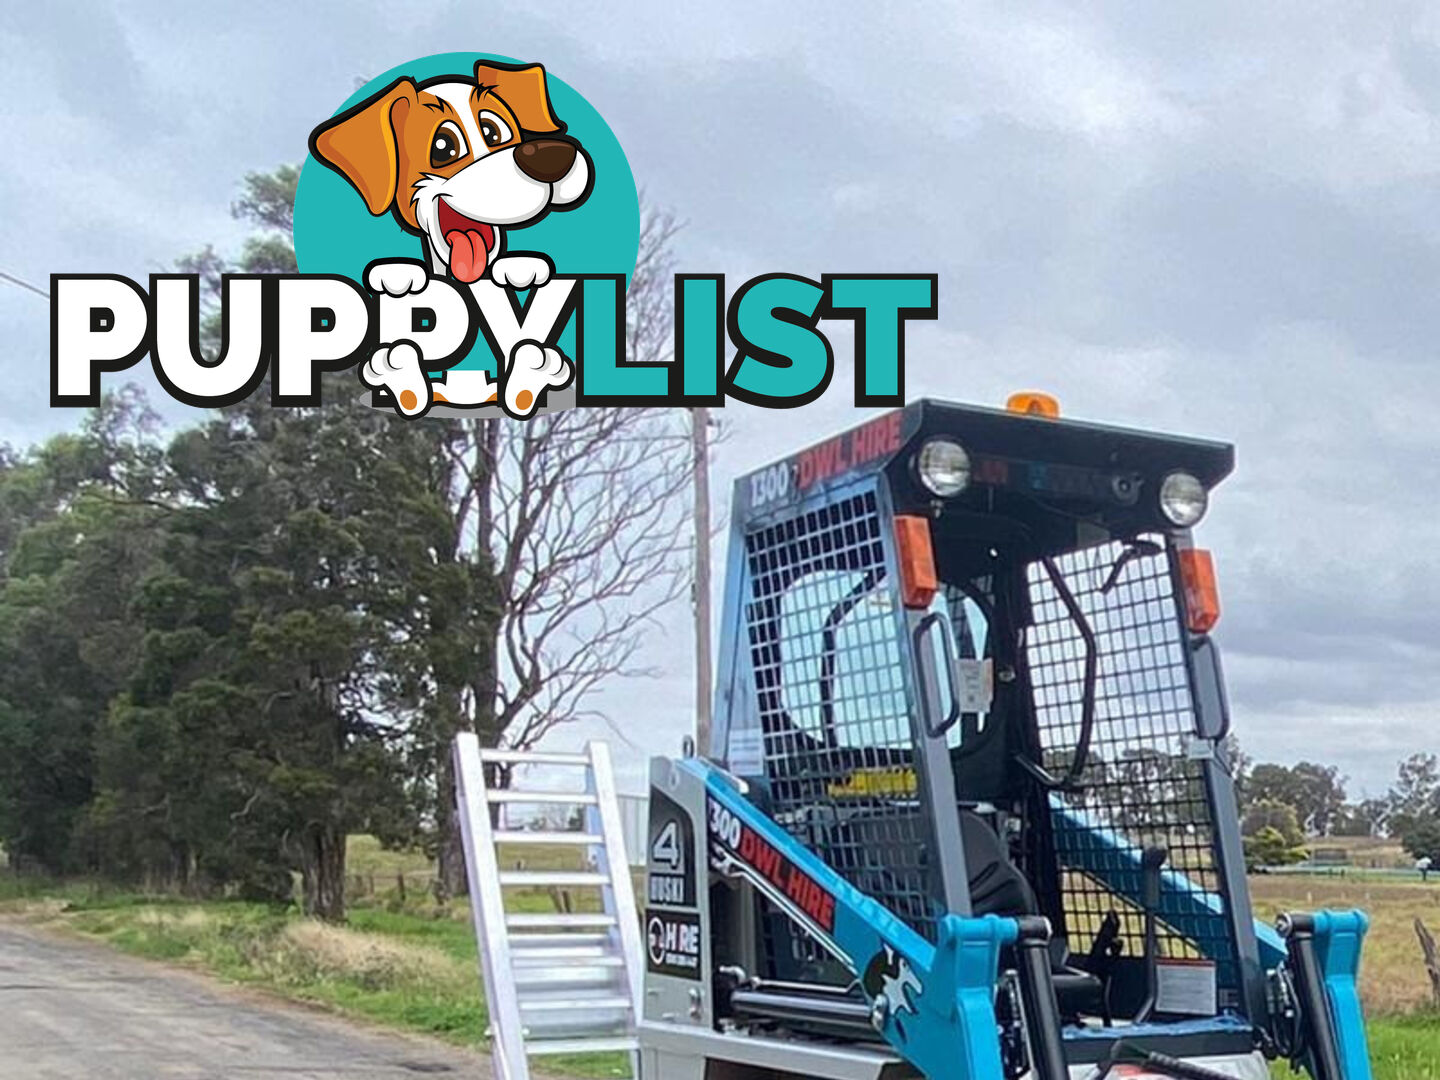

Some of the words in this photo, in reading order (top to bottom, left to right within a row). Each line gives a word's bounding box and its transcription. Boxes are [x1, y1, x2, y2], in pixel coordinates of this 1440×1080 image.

[751, 461, 789, 507] 1300
[798, 440, 847, 490] DWL
[851, 410, 904, 464] HIRE
[652, 821, 680, 869] 4
[740, 827, 784, 888] DWL
[788, 867, 834, 928] HIRE
